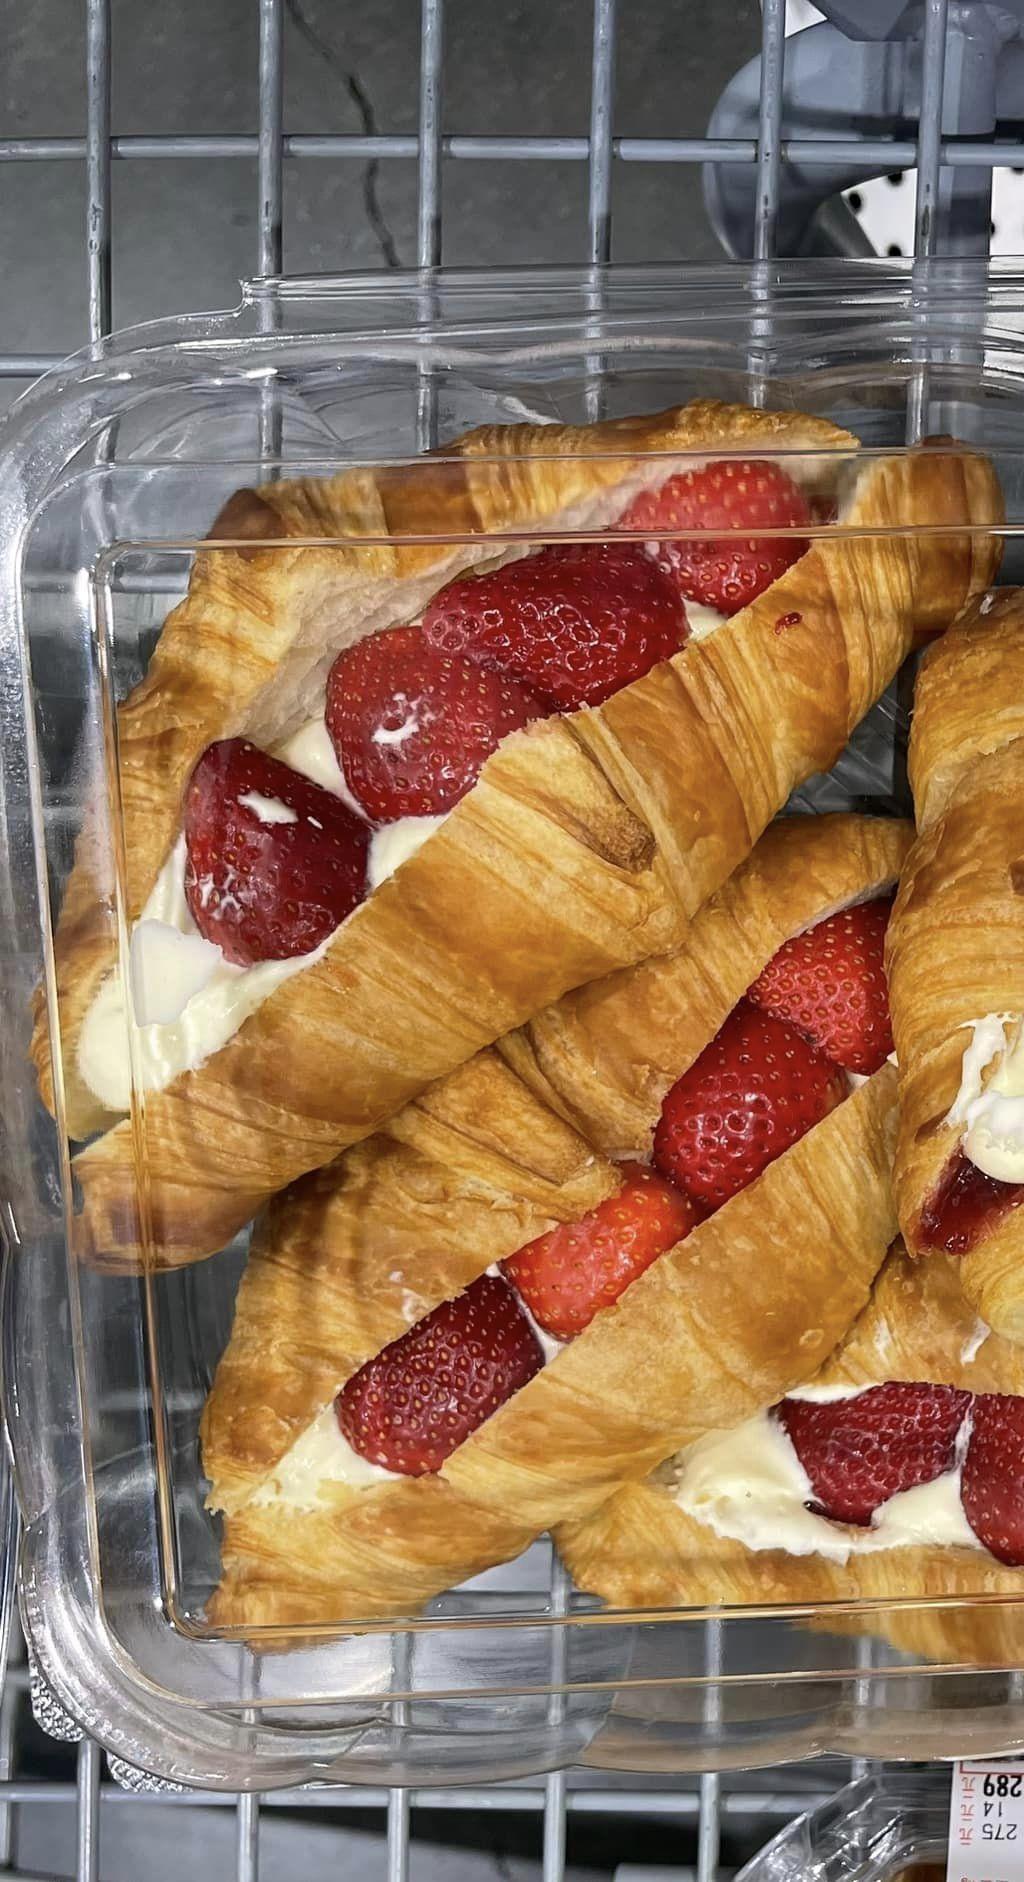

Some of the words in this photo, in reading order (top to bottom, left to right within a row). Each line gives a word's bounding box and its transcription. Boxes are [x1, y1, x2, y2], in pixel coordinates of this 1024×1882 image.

[962, 1777, 975, 1799] 元
[984, 1775, 1022, 1797] 289
[961, 1804, 974, 1821] 元
[984, 1801, 1002, 1817] 14
[959, 1828, 973, 1845] 元
[982, 1824, 1017, 1840] 275
